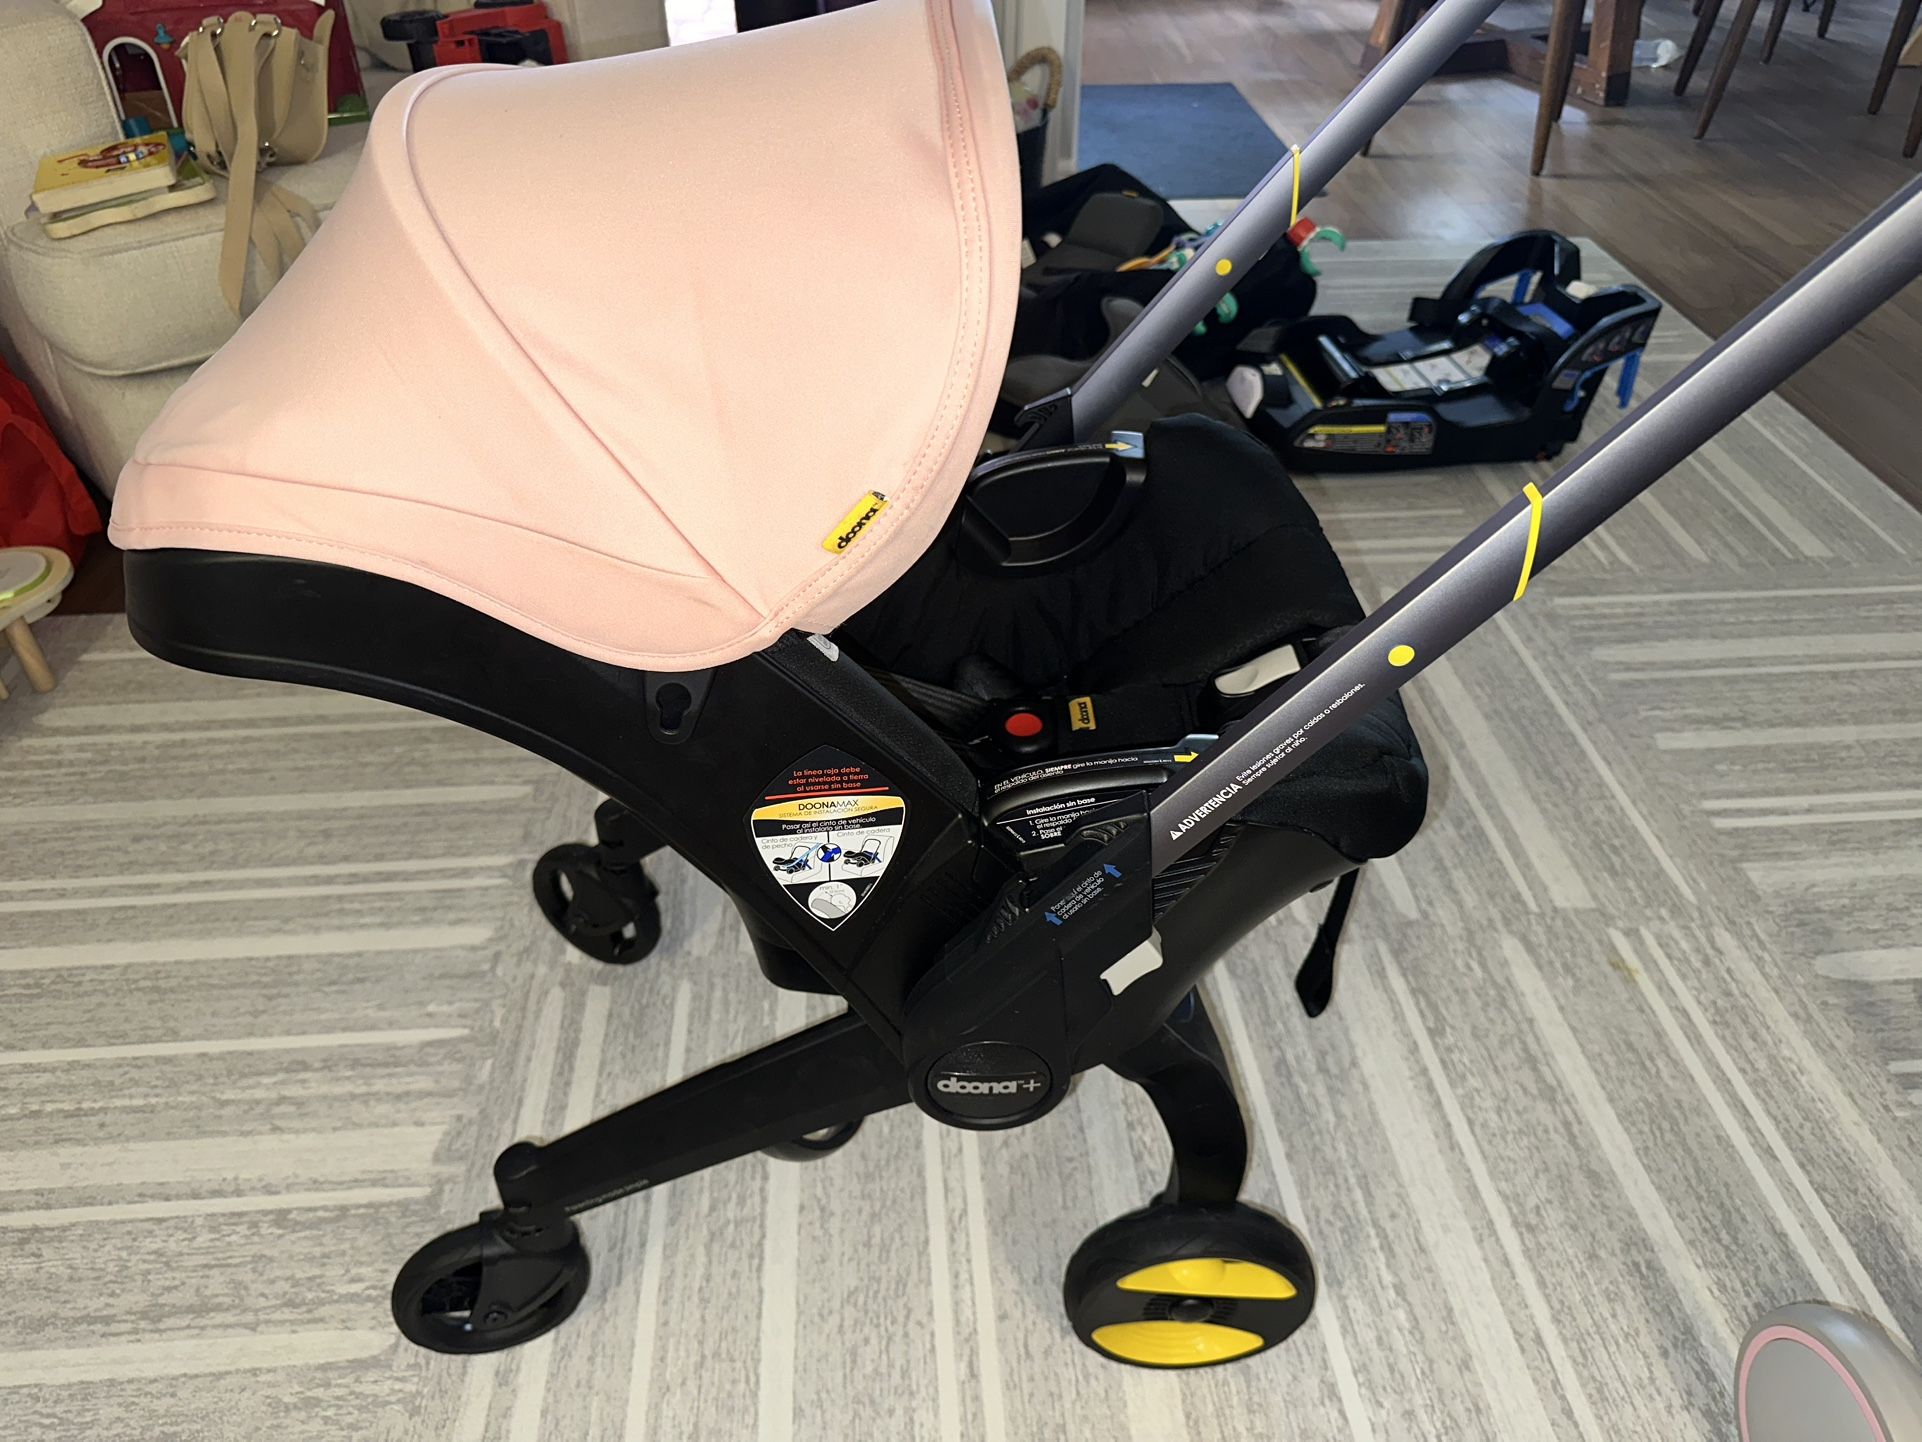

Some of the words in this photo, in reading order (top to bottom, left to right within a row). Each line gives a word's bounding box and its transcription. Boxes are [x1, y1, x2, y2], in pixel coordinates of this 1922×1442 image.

[838, 507, 878, 549] doona
[1235, 769, 1252, 782] Evite
[1250, 752, 1274, 770] lesiones
[1272, 737, 1294, 755] graves
[1292, 728, 1304, 740] por
[1329, 684, 1366, 710] resbalones.
[824, 767, 839, 775] roja
[1044, 763, 1072, 774] SIEMPRE
[1072, 762, 1086, 770] gire
[1094, 758, 1118, 766] manija
[1242, 766, 1267, 785] Siempre
[1265, 752, 1286, 768] sujetar
[788, 777, 806, 785] estar
[808, 775, 841, 783] nivelada
[798, 799, 859, 811] DOONAMAX
[1026, 803, 1066, 815] Instalación
[1077, 797, 1096, 805] base
[1178, 783, 1243, 832] ADVERTENCIA
[778, 811, 803, 819] SISTEMA
[819, 819, 837, 827] cinto
[848, 816, 877, 824] vehículo
[1035, 817, 1049, 825] Gire
[1057, 812, 1080, 821] manija
[804, 825, 833, 833] instalarlo
[1043, 818, 1073, 828] respaldo
[1040, 832, 1062, 840] SOBRE
[1081, 876, 1095, 889] cinto
[1093, 870, 1103, 878] de
[1057, 900, 1077, 916] cadera
[1075, 893, 1084, 901] de
[1082, 877, 1105, 895] vehículo
[1062, 912, 1069, 920] al
[1068, 903, 1083, 916] usarlo
[1081, 897, 1090, 905] sin
